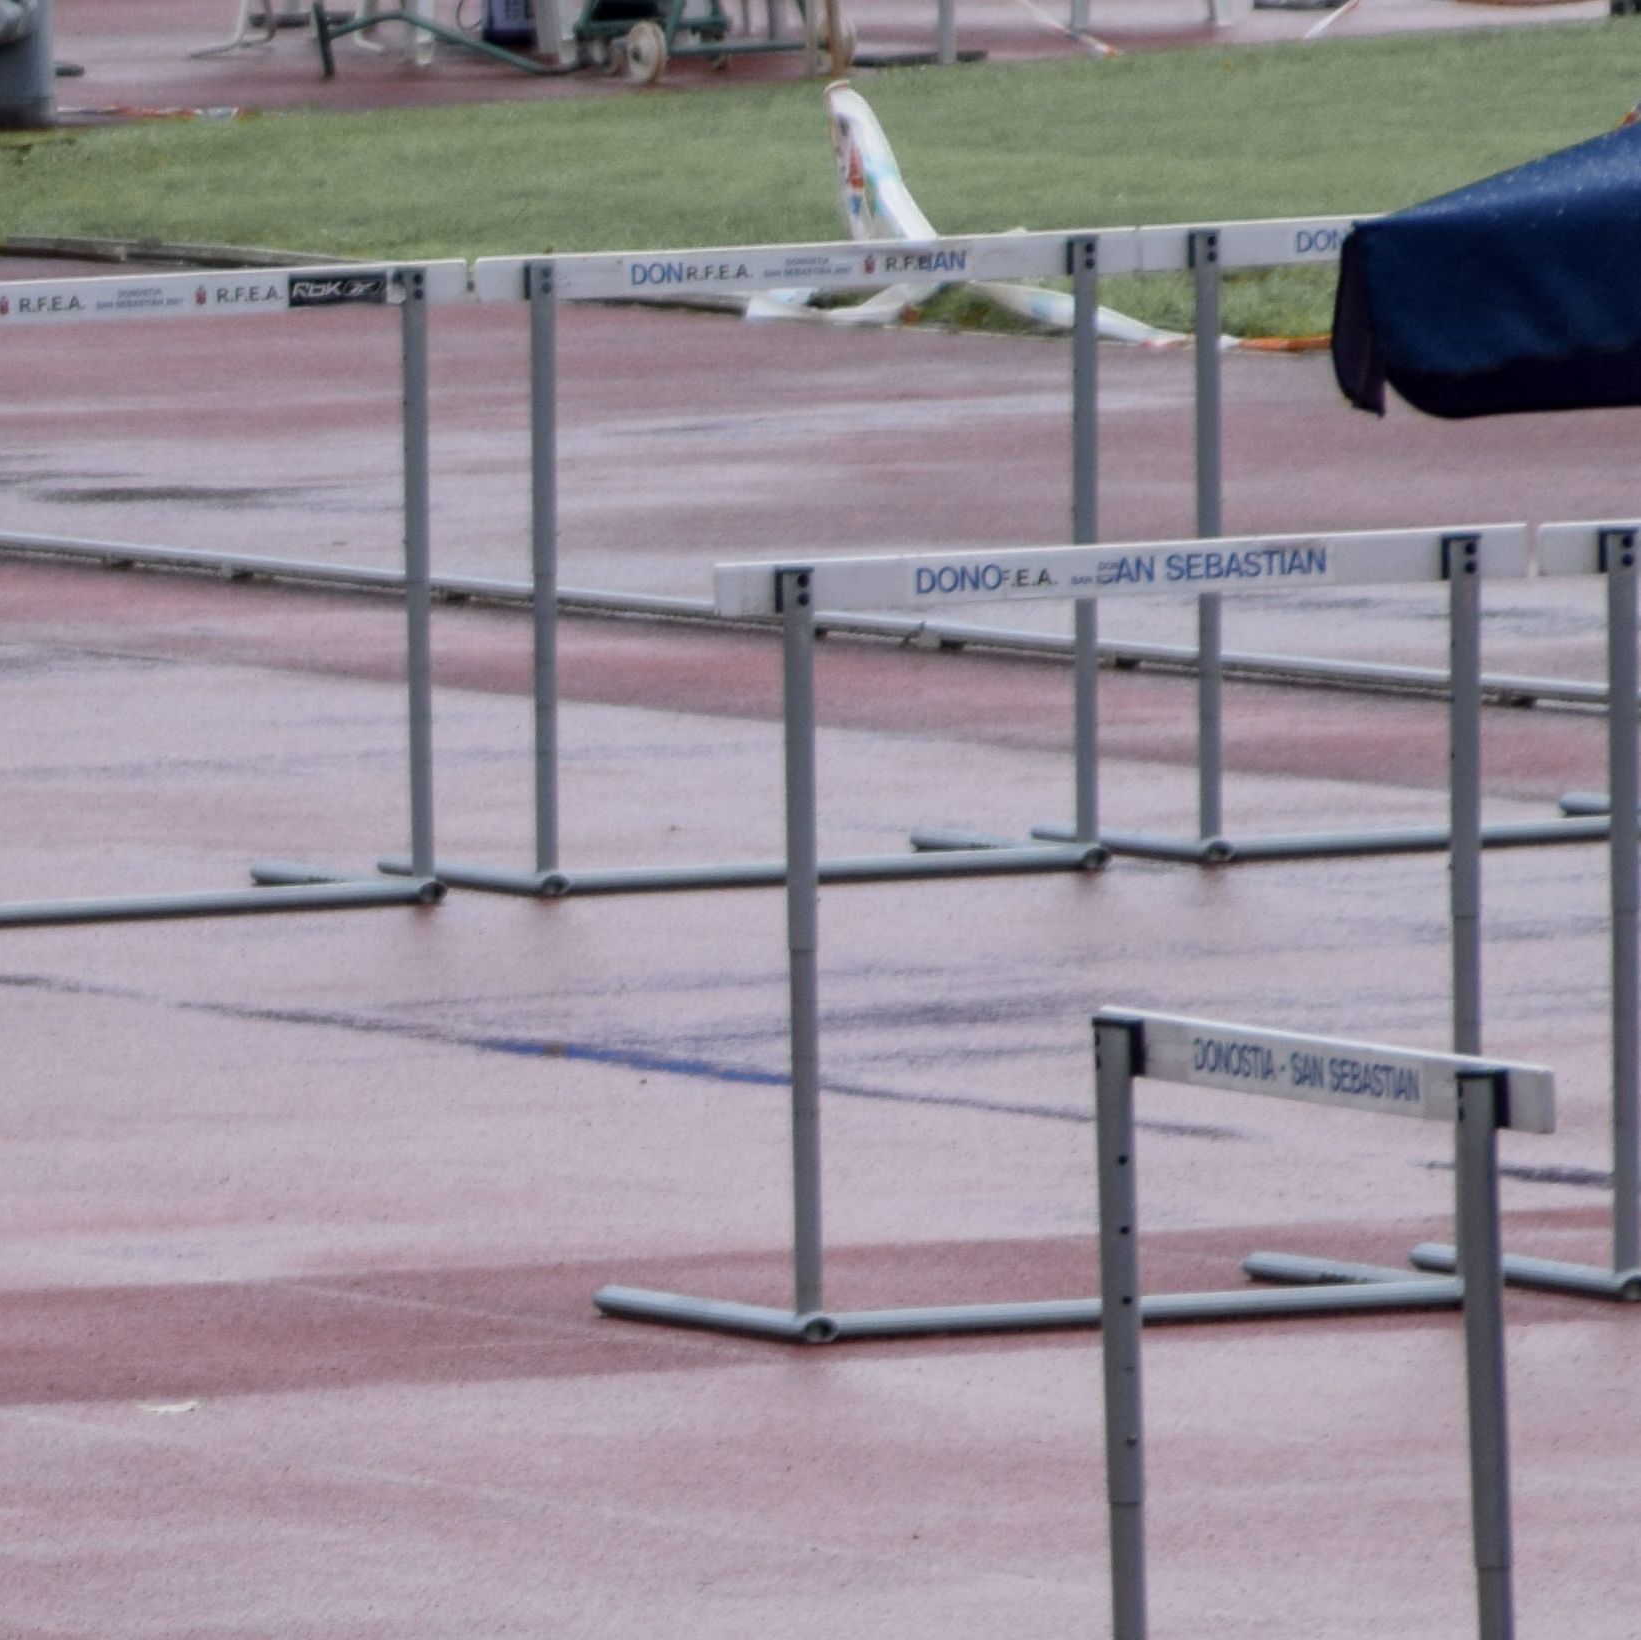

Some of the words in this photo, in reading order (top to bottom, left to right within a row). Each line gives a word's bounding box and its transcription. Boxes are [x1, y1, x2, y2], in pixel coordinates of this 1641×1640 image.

[685, 263, 754, 281] R.F.E.A.
[216, 286, 283, 303] R.F.E.A.
[18, 295, 86, 313] R.F.E.A.
[1165, 548, 1328, 582] SEBASTIAN
[1193, 1037, 1275, 1080] DONOSTIA
[1290, 1051, 1326, 1090] SAN
[1328, 1057, 1421, 1102] SEBASTIAN
